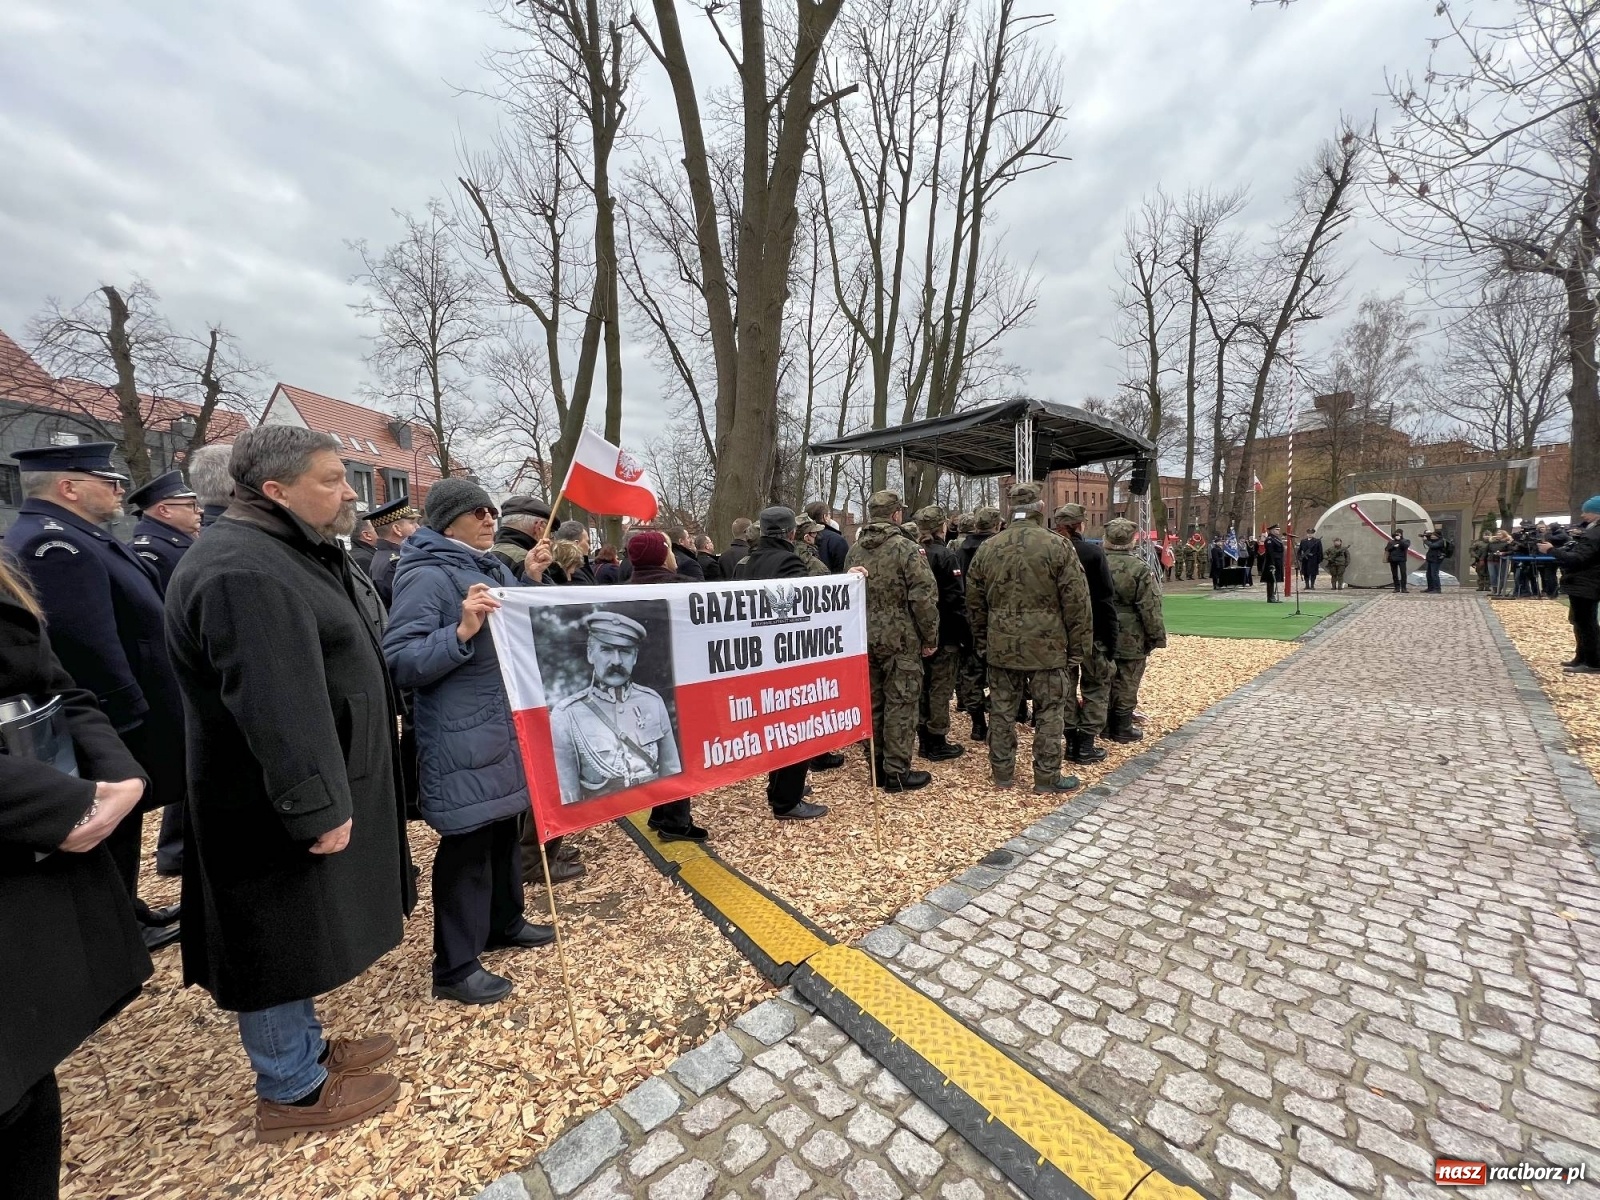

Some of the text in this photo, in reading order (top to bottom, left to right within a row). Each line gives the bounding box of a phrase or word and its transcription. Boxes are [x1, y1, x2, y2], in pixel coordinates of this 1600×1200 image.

[688, 584, 851, 625] GAZETA POLSKA
[707, 625, 844, 674] KLUB GLIWICE
[728, 676, 839, 722] im. Marszałka
[703, 706, 861, 769] Józefa Piłsudskiego
